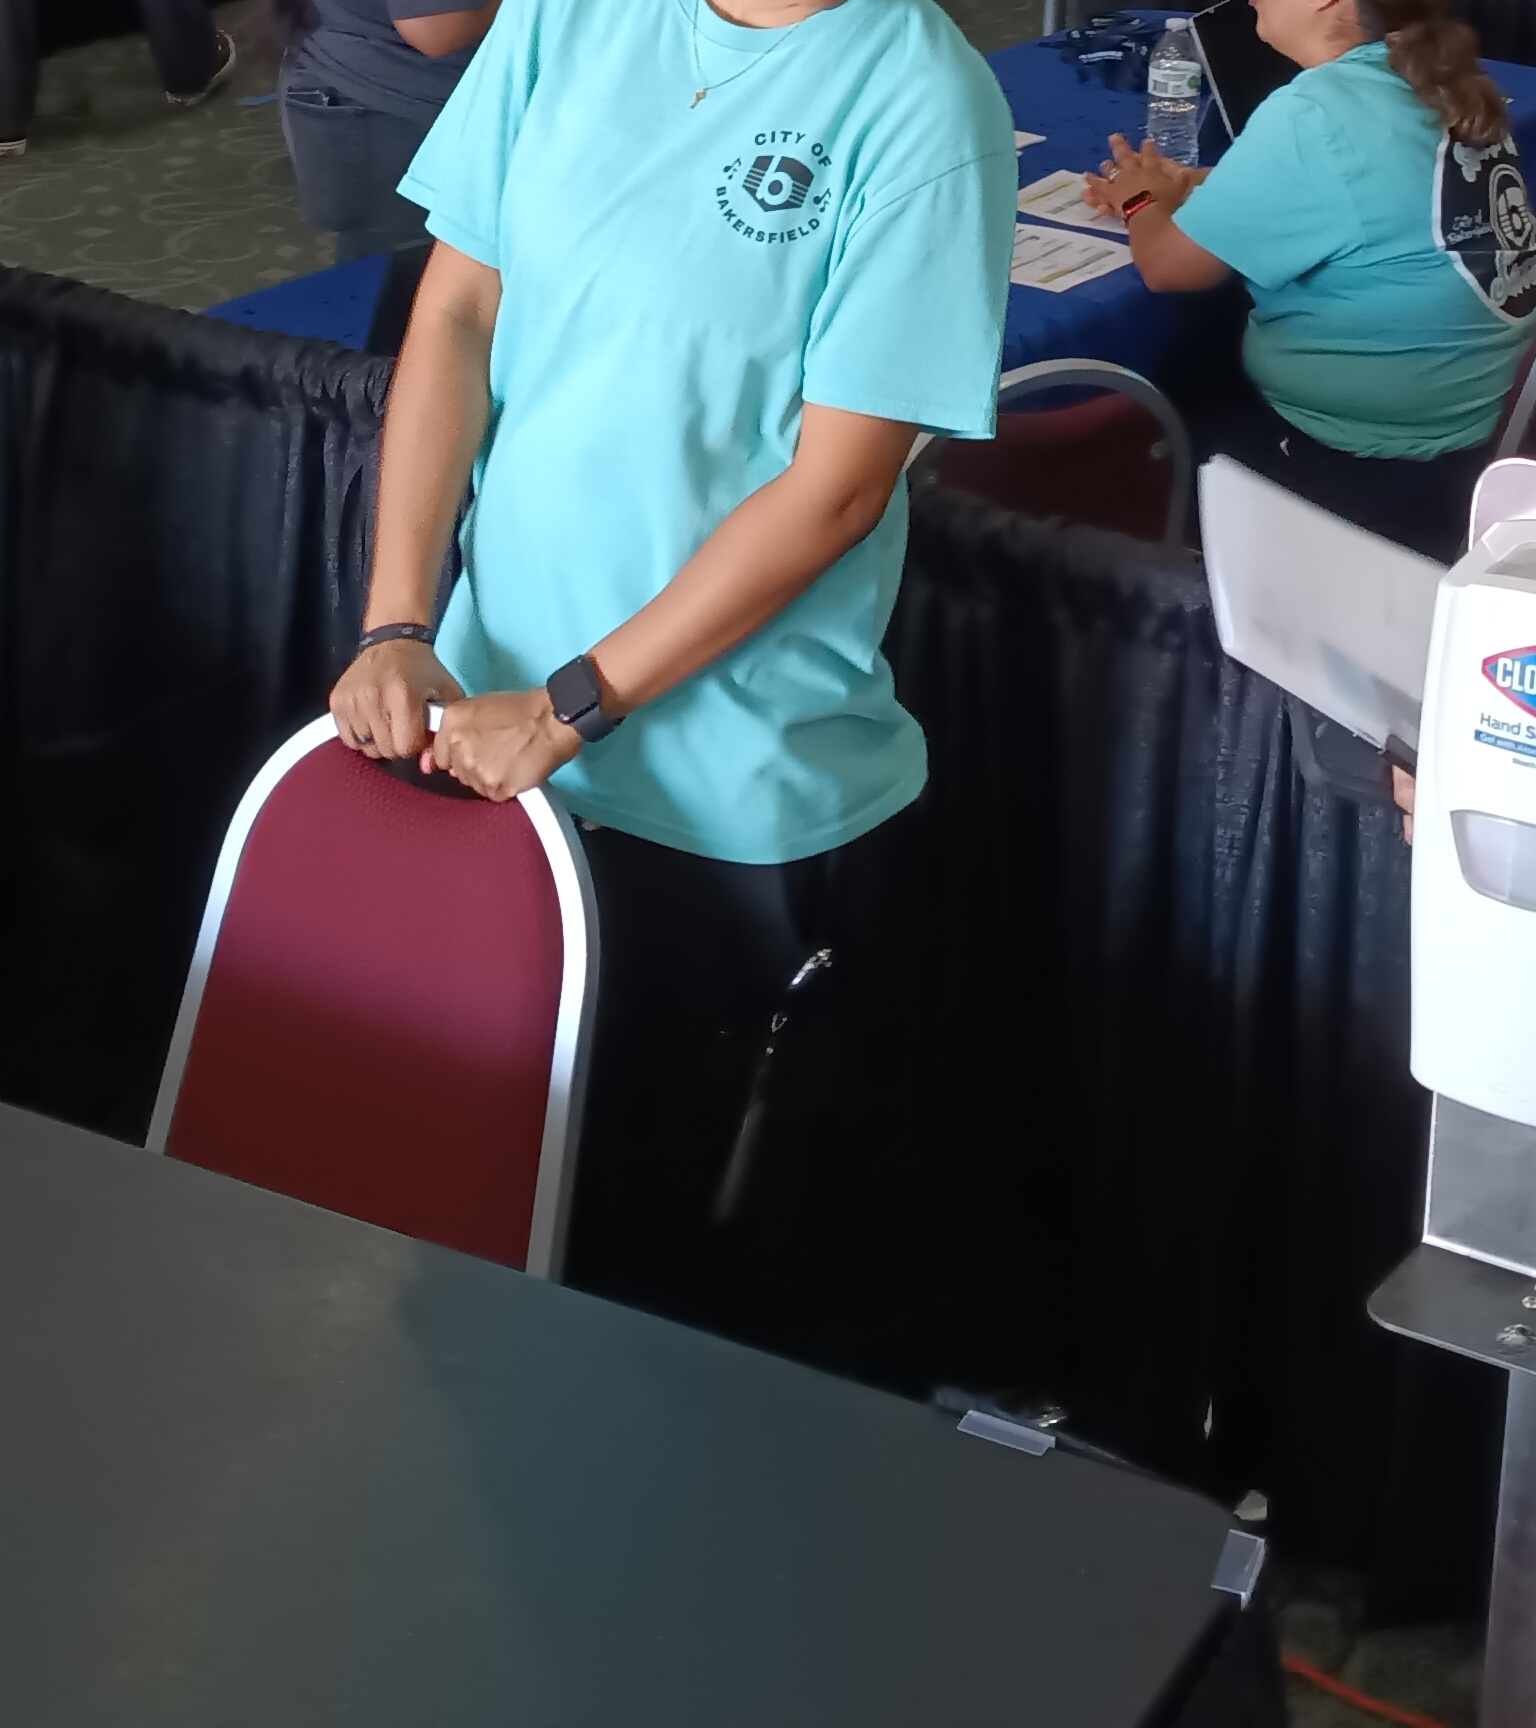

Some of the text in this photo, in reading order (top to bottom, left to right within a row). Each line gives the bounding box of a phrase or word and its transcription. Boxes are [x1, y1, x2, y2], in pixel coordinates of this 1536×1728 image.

[754, 130, 833, 168] CITY OF
[716, 185, 821, 245] BAKERSFIELD
[1479, 712, 1522, 736] Hand
